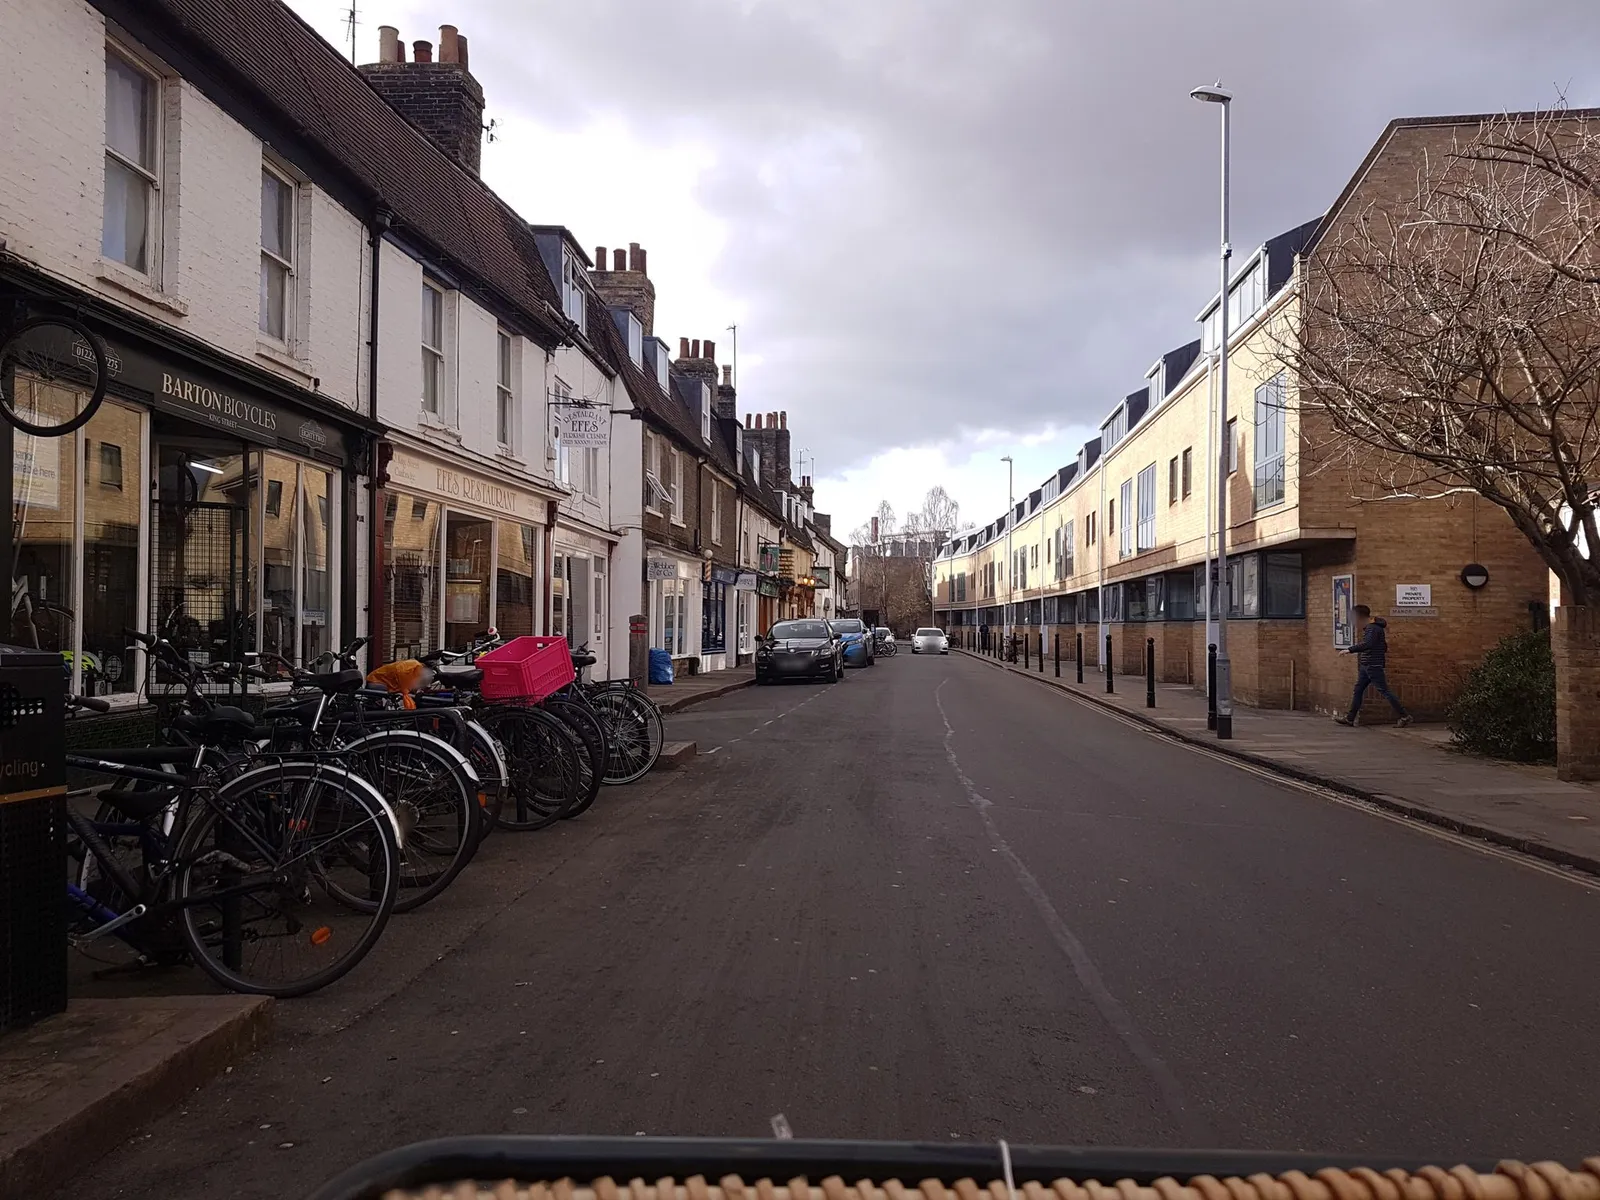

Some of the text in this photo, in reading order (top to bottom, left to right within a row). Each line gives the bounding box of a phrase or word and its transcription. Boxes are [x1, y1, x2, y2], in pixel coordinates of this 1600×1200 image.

[162, 372, 277, 430] BARTON BICYCLES
[209, 413, 238, 429] KING STREET
[563, 411, 607, 425] RESTAURANT
[571, 420, 599, 432] EFES
[40, 465, 56, 479] here
[436, 468, 460, 495] EFES
[463, 477, 517, 512] RESTAURANT
[654, 561, 676, 570] Webber
